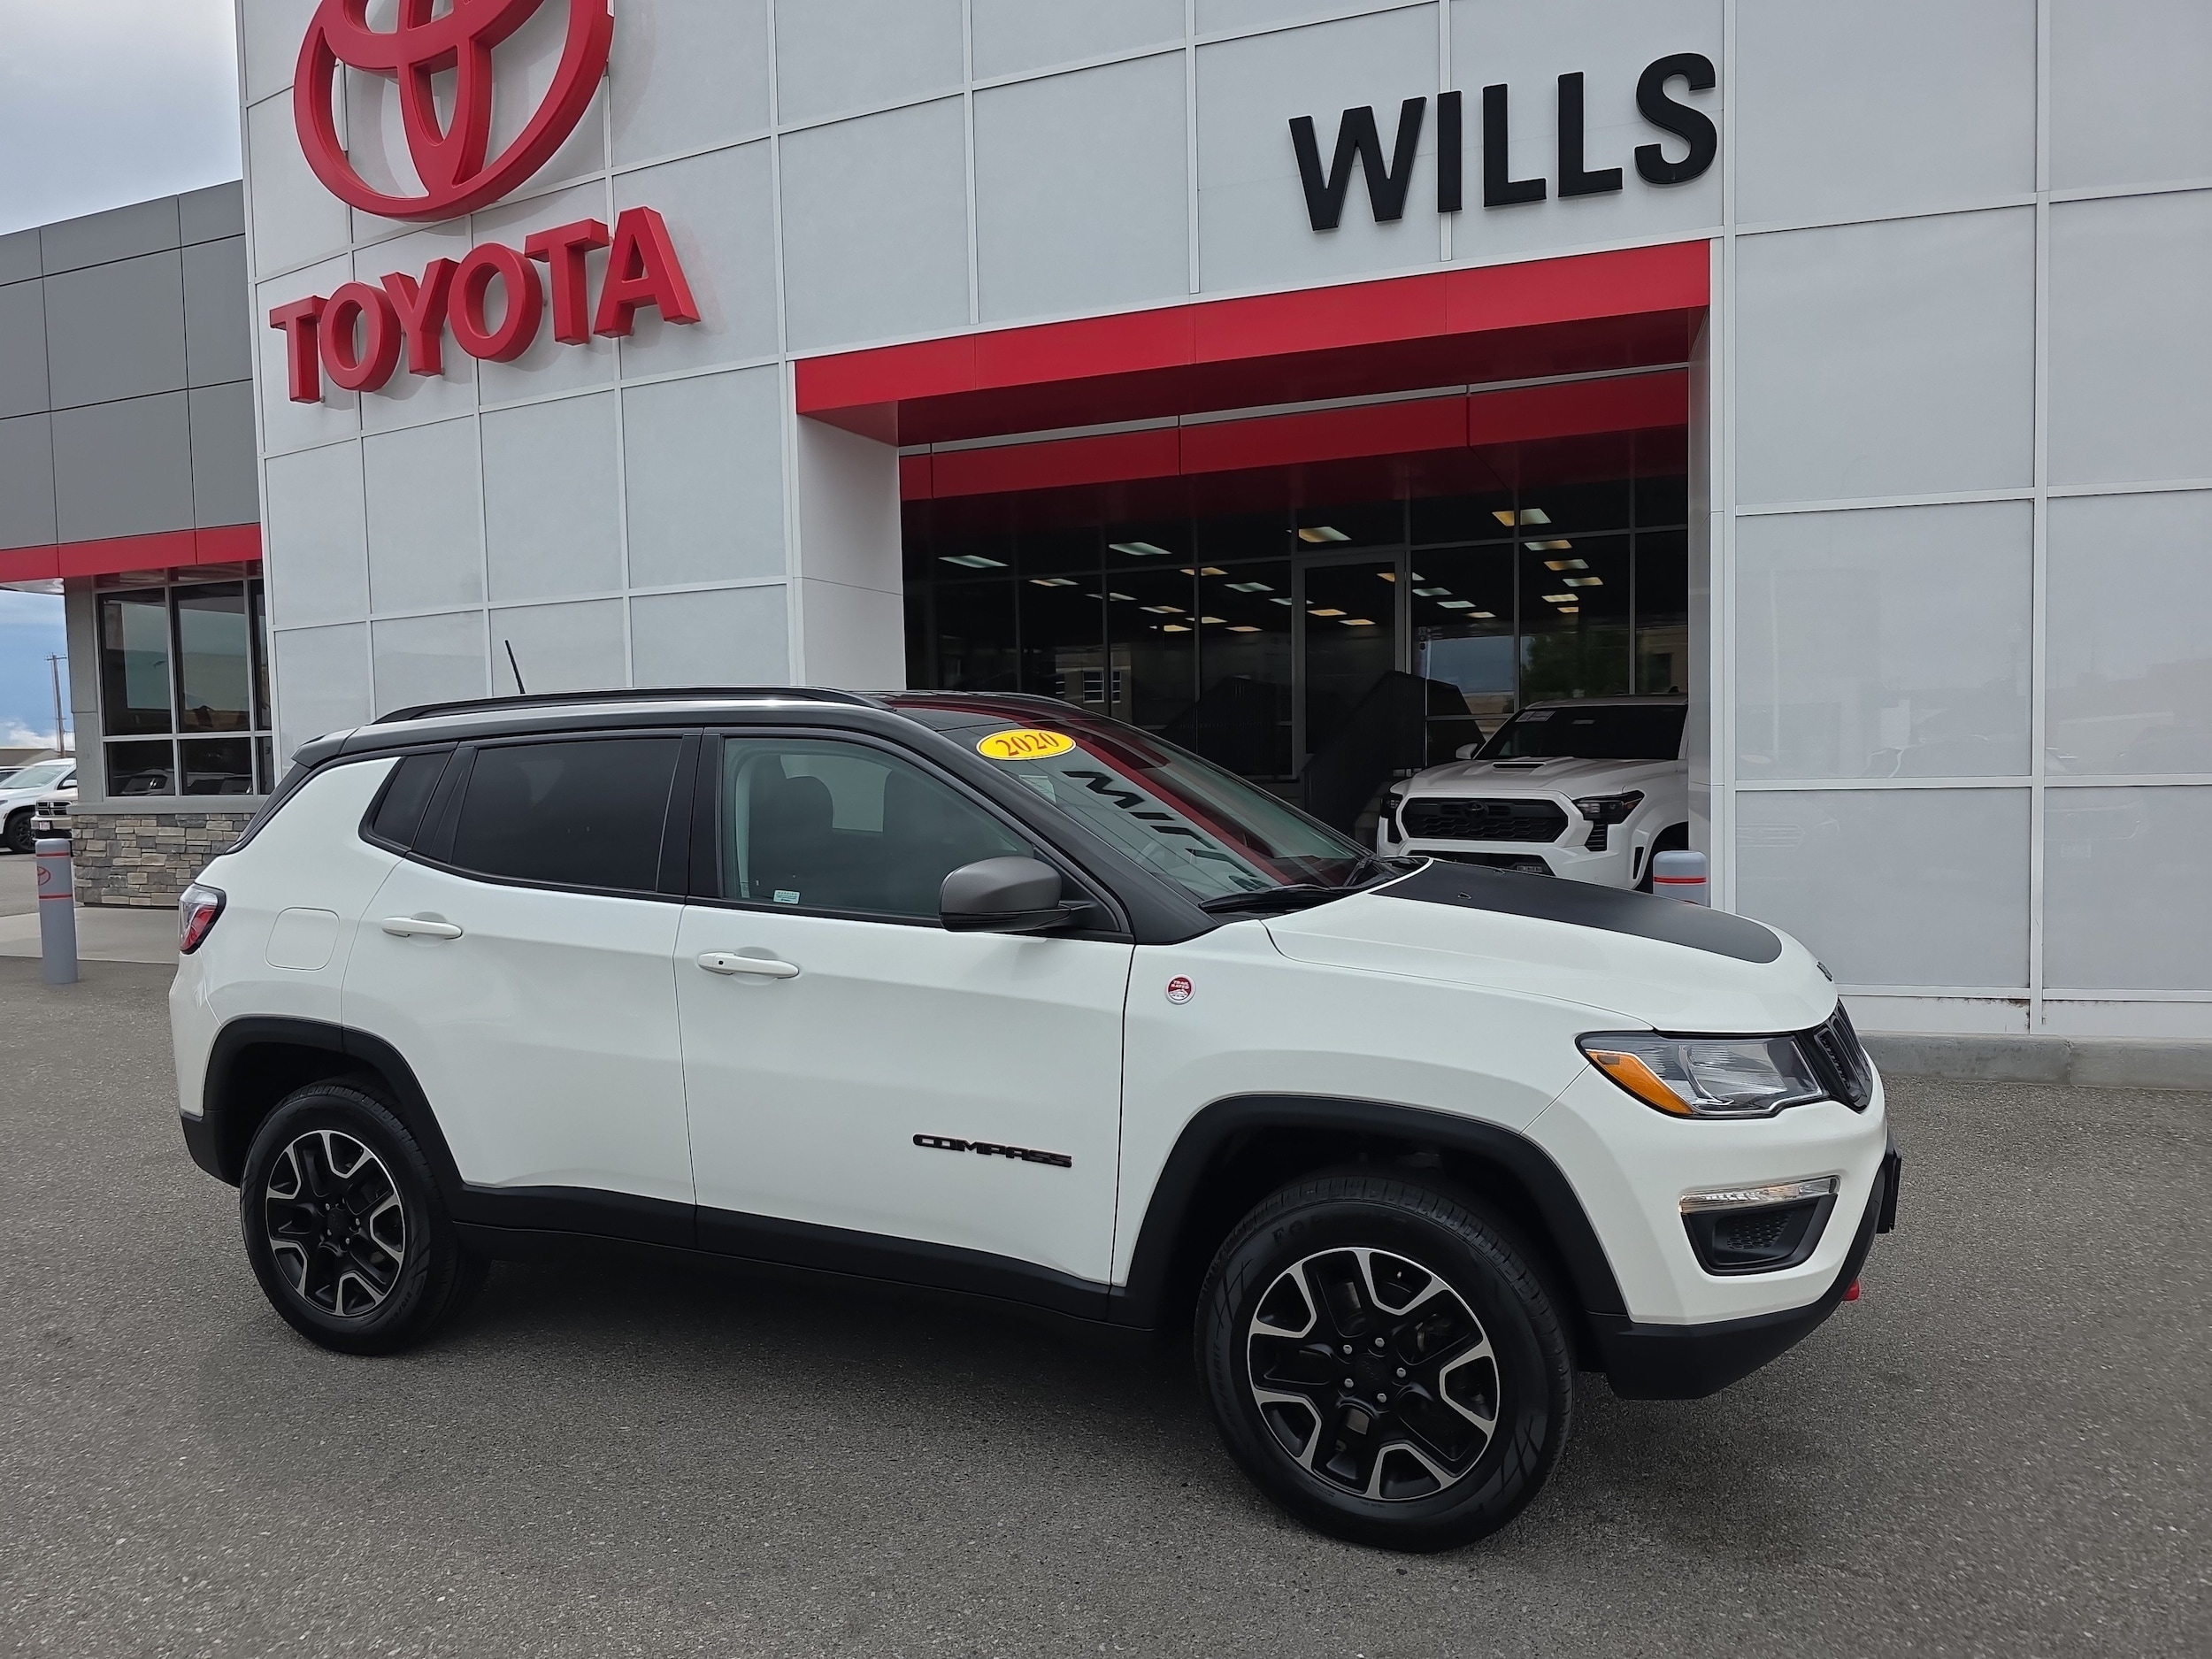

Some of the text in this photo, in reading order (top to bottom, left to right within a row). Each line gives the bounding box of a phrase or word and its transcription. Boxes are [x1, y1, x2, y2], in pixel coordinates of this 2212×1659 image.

[1288, 52, 1717, 232] WILLS
[269, 206, 701, 404] TOYOTA
[995, 732, 1060, 757] 2020
[912, 1133, 1072, 1168] COMPASS
